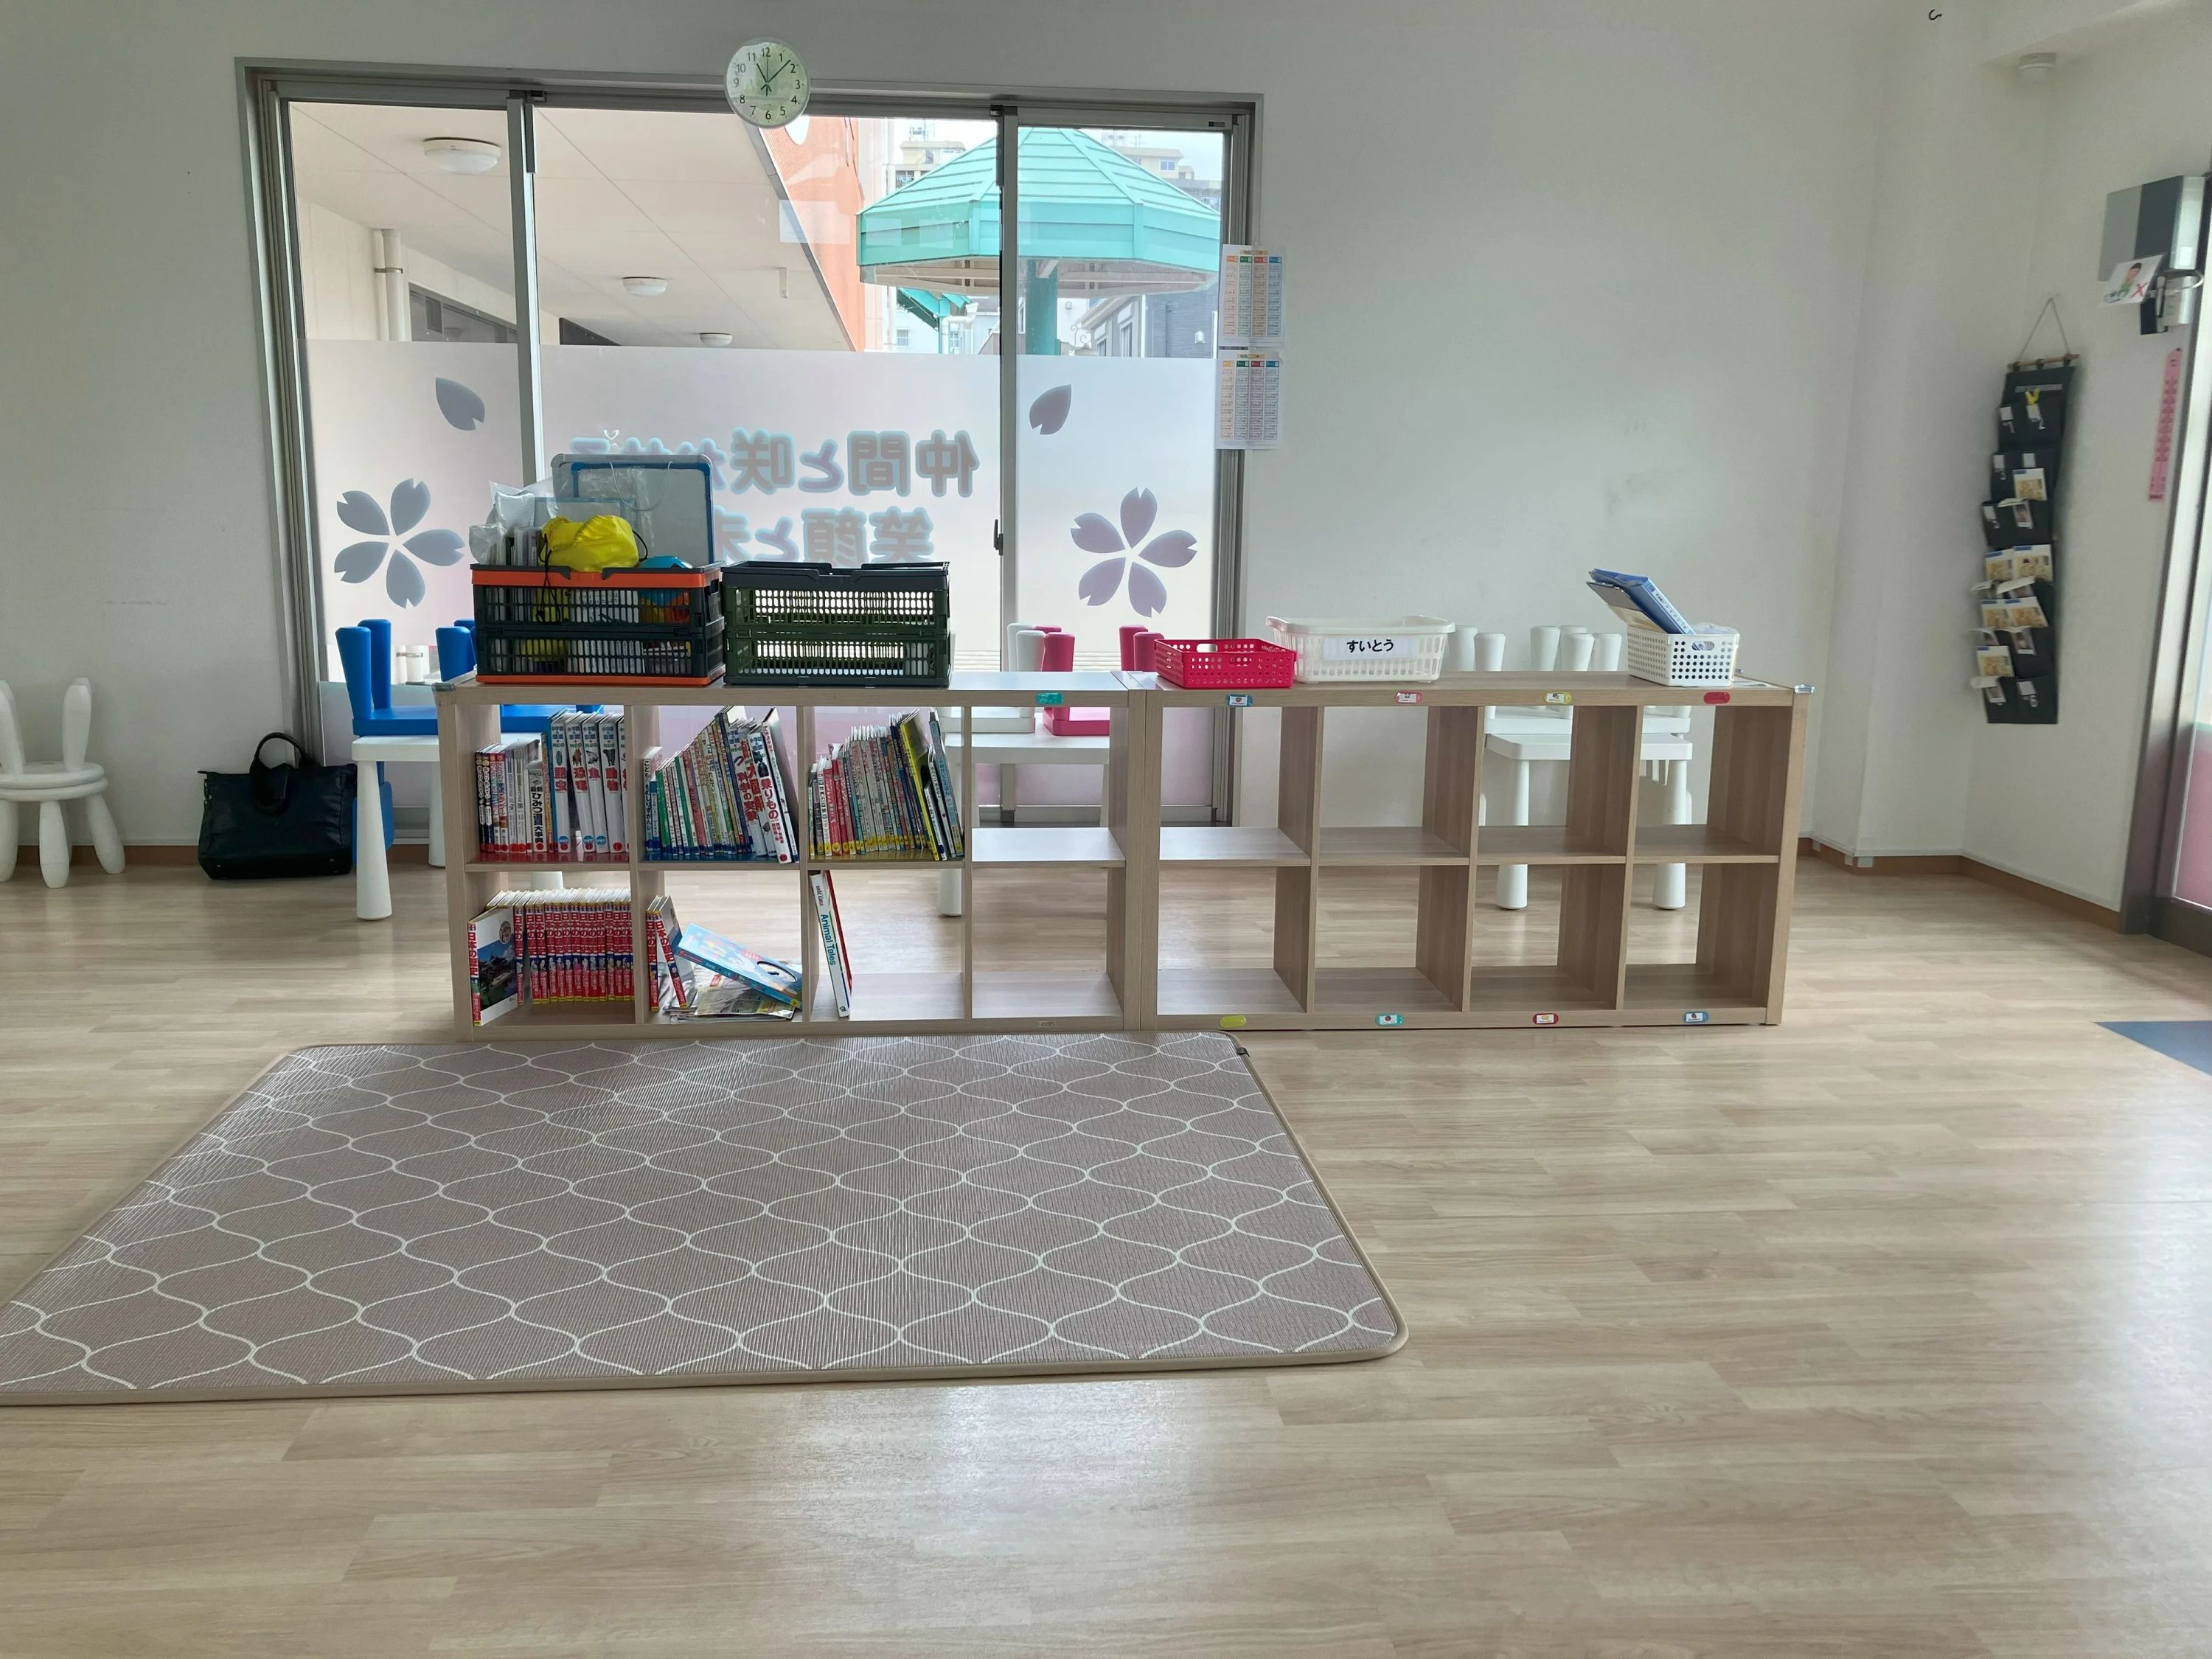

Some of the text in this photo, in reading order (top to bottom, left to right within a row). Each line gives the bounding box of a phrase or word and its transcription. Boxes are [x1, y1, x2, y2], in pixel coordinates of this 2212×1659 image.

[747, 52, 757, 62] 11
[761, 47, 771, 58] 12
[779, 52, 783, 62] 1
[736, 63, 746, 73] 10
[790, 63, 796, 74] 2
[733, 77, 740, 88] 9
[796, 80, 801, 89] 3
[740, 94, 745, 104] 8
[790, 95, 798, 105] 4
[751, 105, 757, 115] 7
[765, 110, 771, 120] 6
[779, 106, 786, 116] 5
[1346, 639, 1394, 653] すいとう
[554, 767, 567, 791] 昆虫
[760, 778, 779, 819] 乗りもの
[821, 914, 836, 966] Animal Tales
